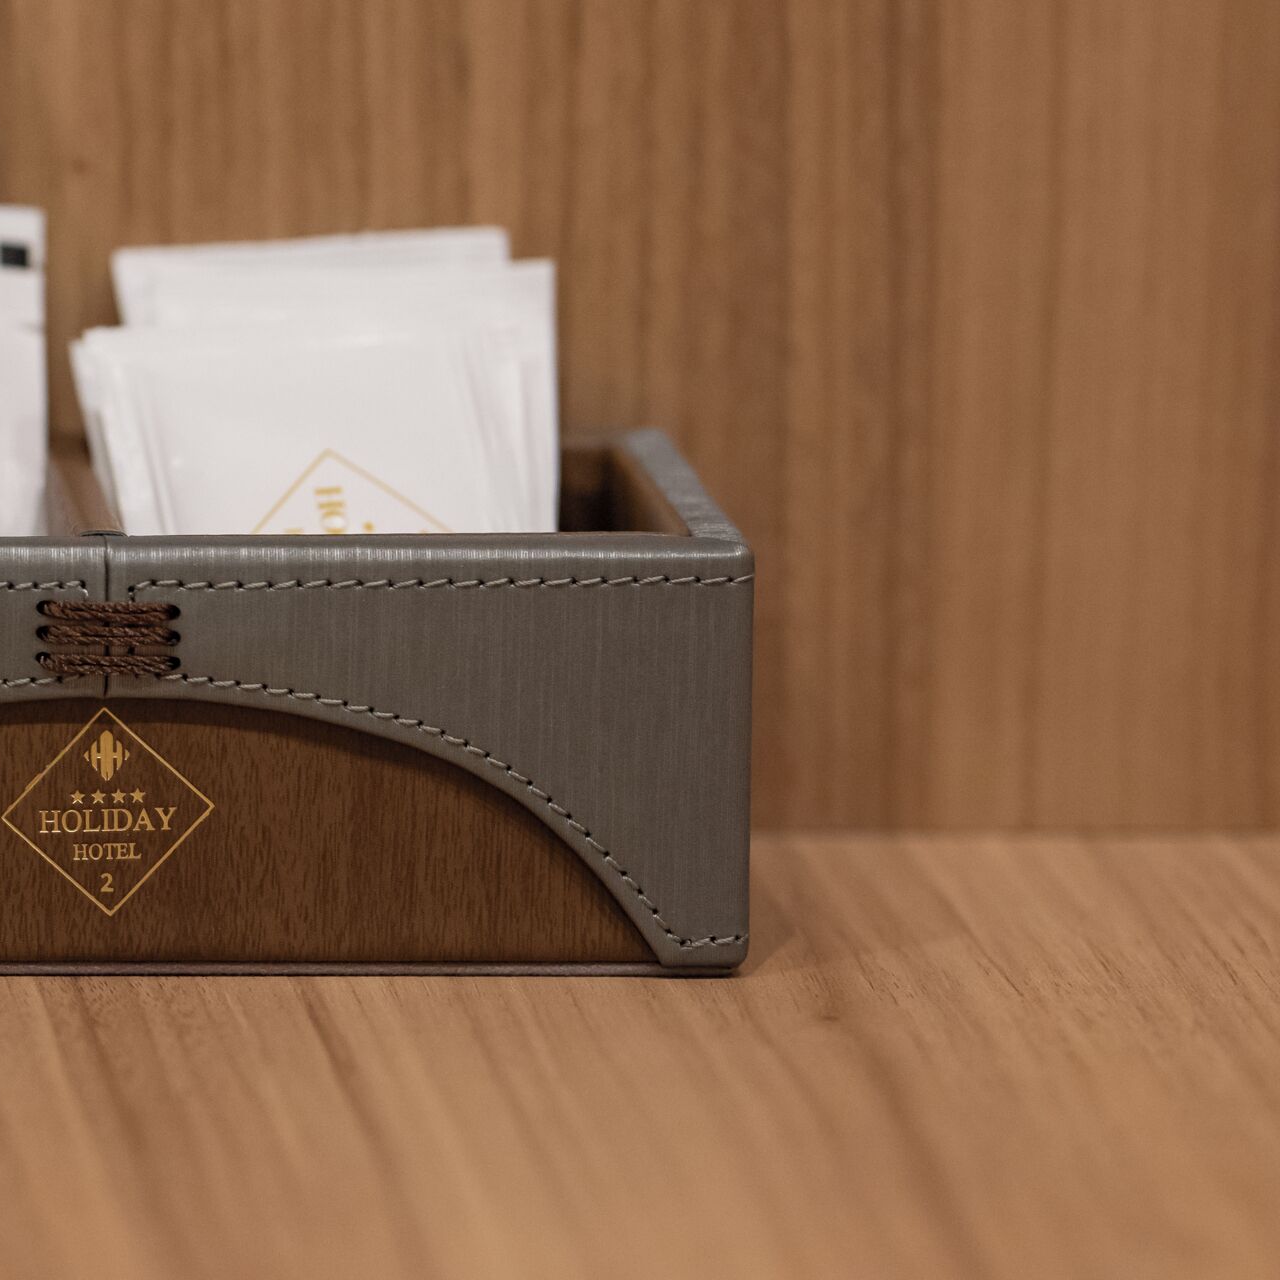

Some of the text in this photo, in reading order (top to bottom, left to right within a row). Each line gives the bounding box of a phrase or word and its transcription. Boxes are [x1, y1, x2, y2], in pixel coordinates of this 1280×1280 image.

[38, 806, 177, 834] HOLIDAY
[72, 842, 143, 861] HOTEL
[100, 872, 114, 893] 2
